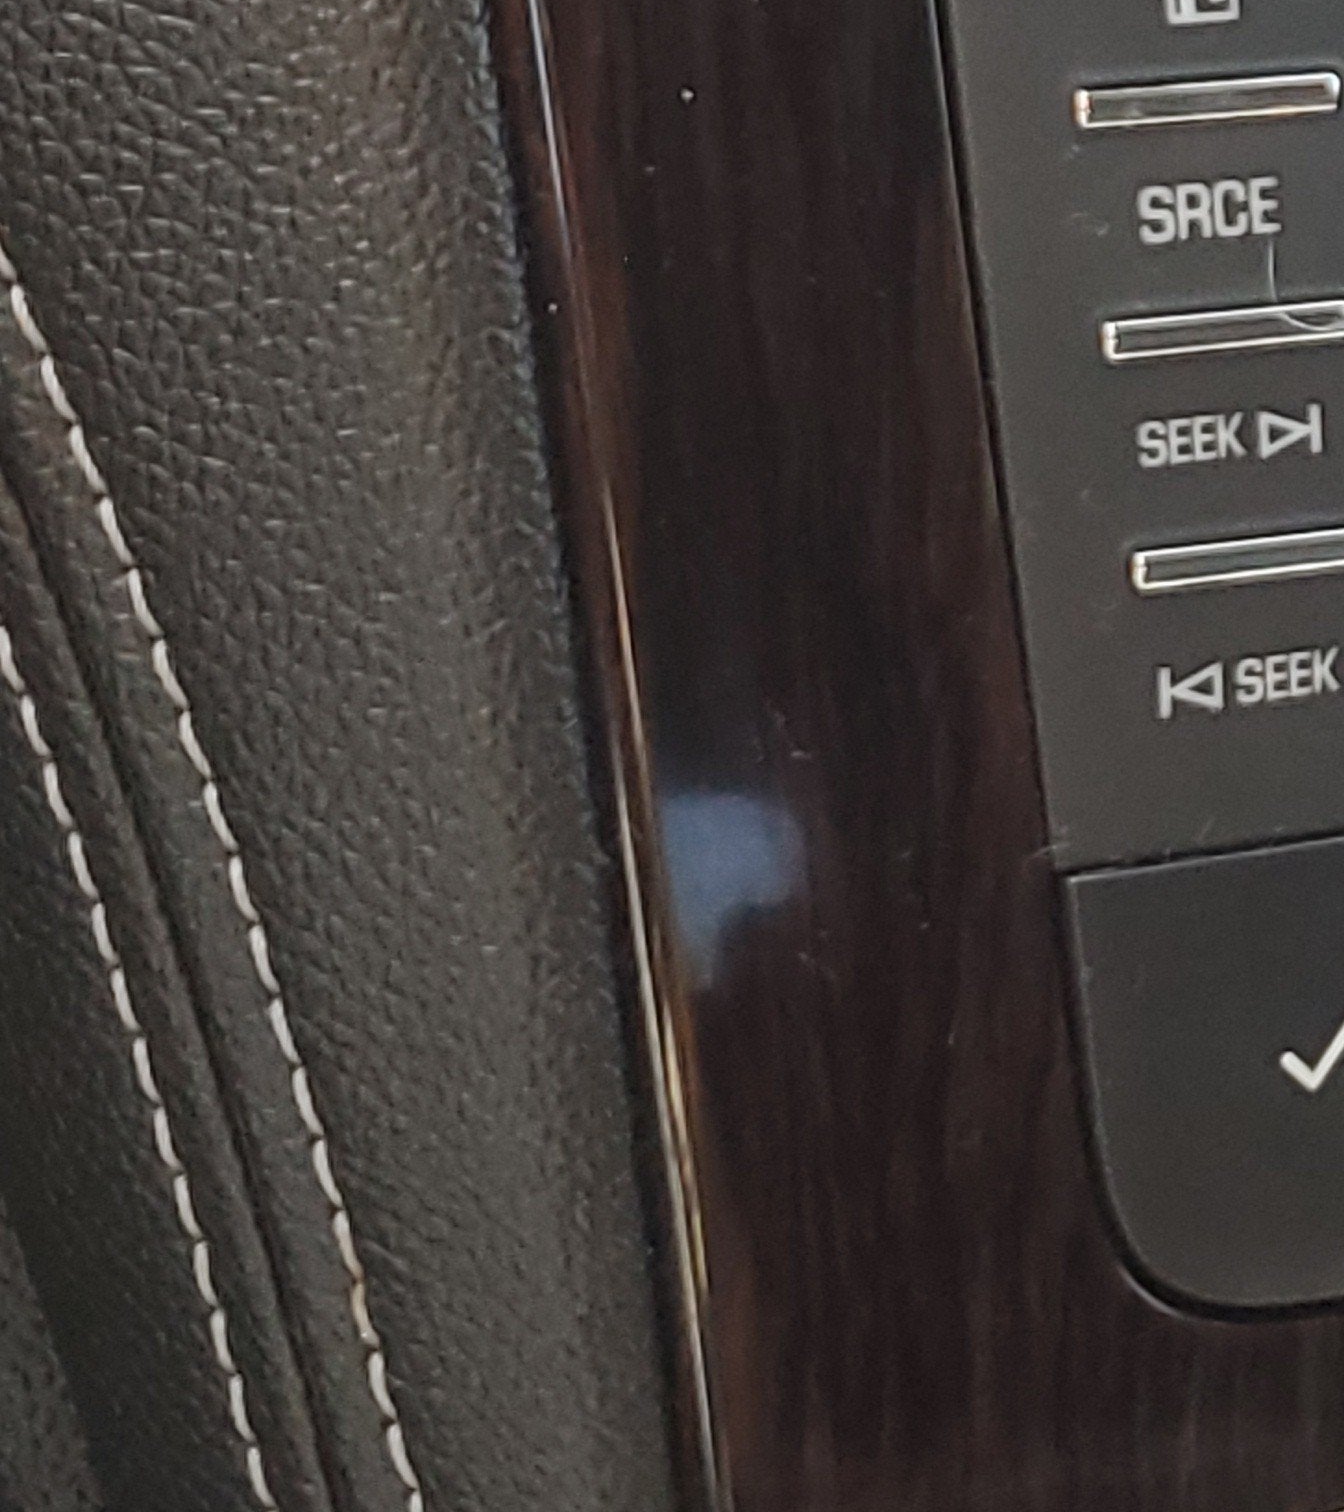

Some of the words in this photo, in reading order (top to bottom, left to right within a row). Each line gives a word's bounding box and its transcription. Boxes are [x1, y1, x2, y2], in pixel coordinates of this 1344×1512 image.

[1137, 176, 1282, 245] SRCE
[1136, 411, 1248, 468] SEEK
[1235, 646, 1341, 705] SEEK
